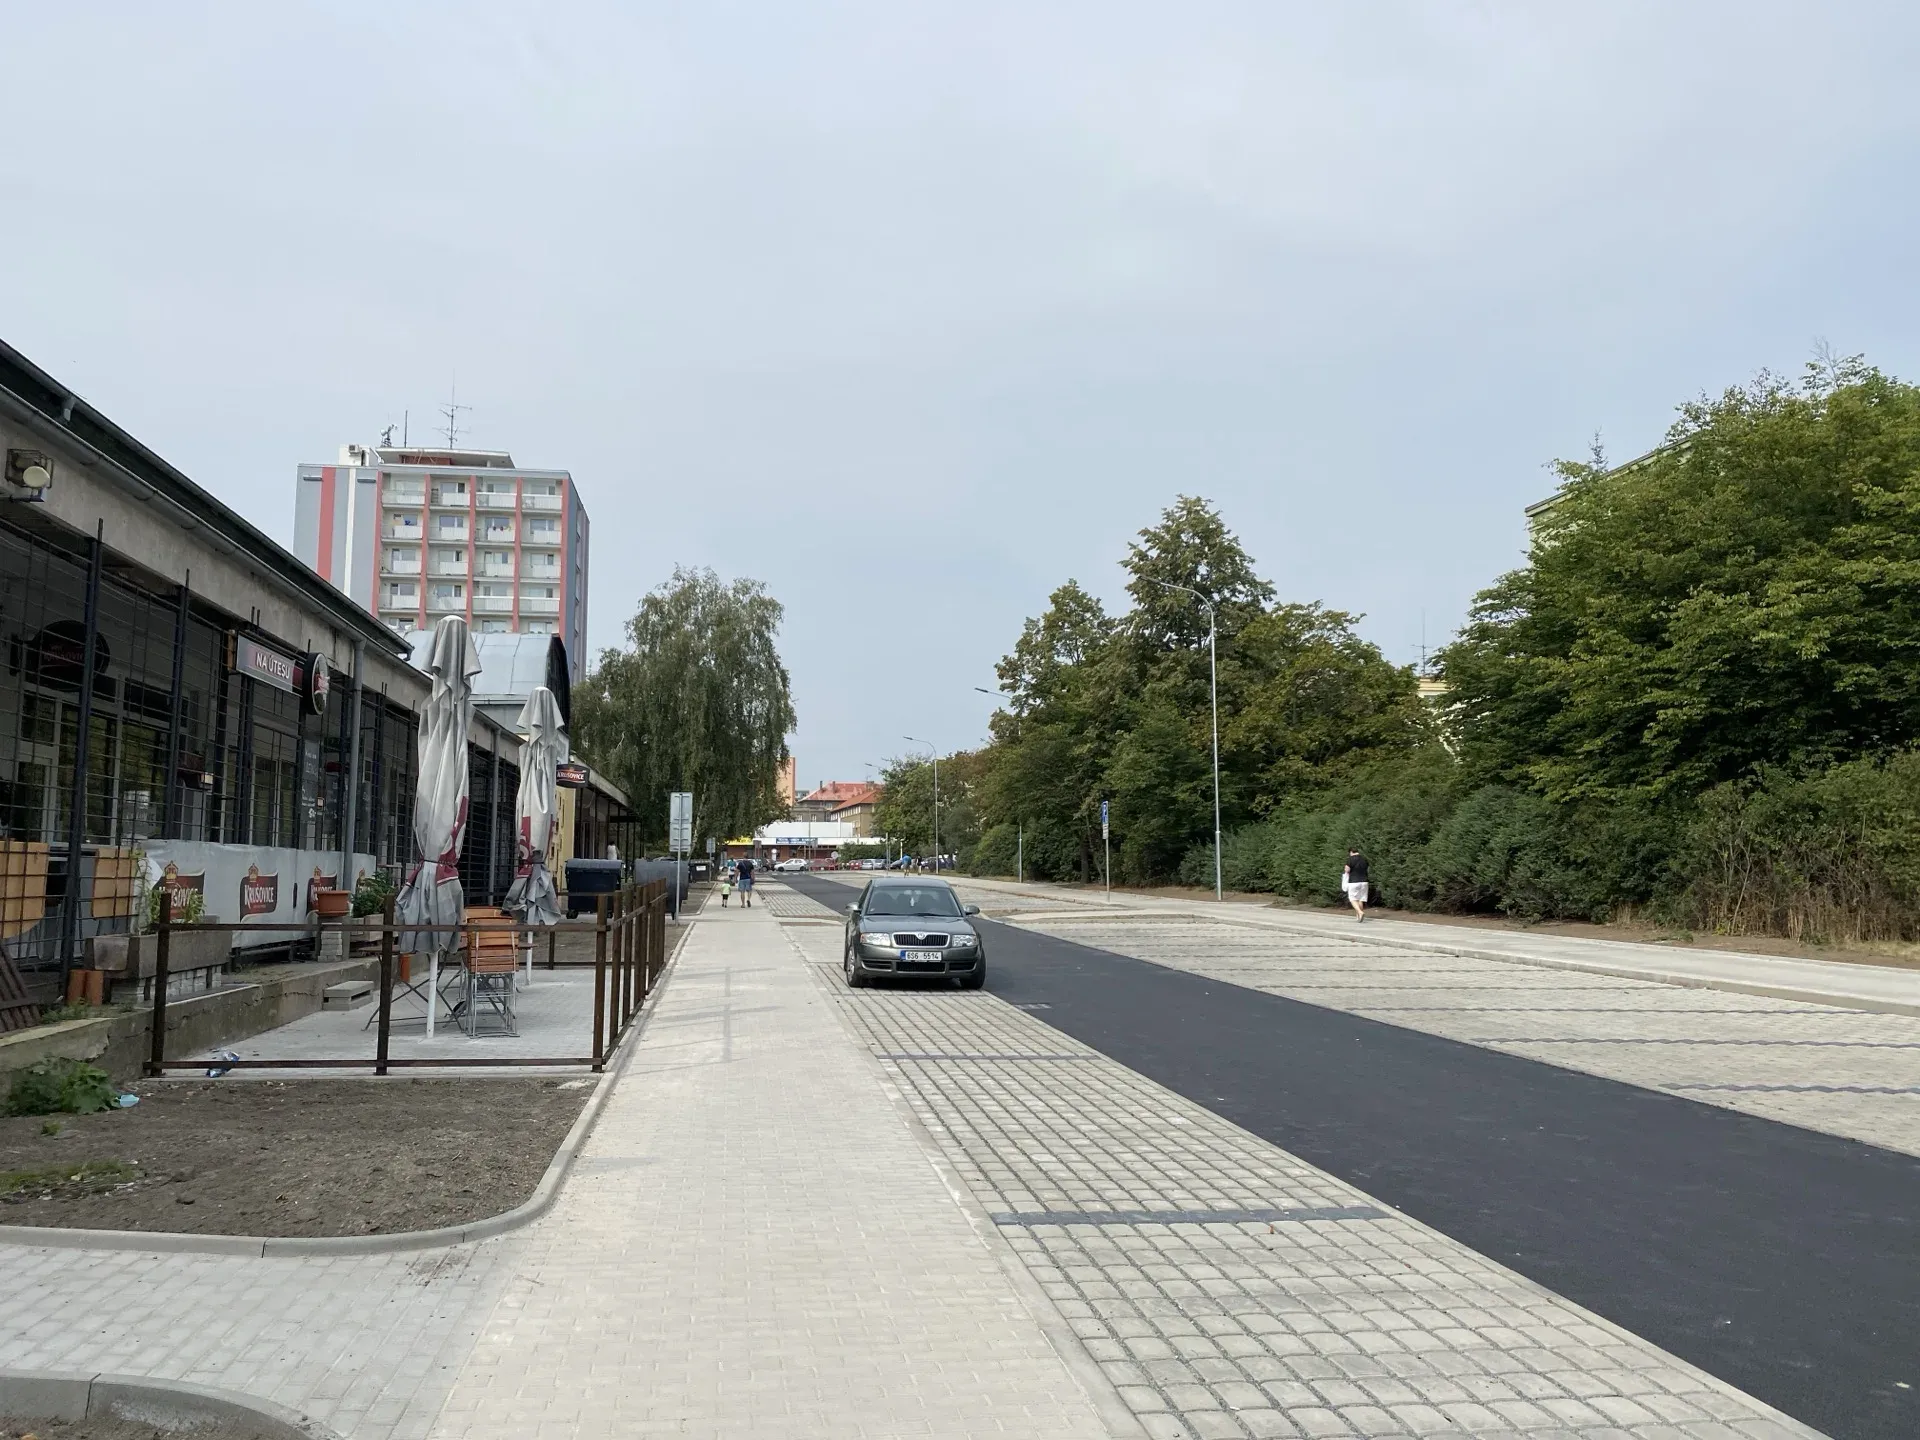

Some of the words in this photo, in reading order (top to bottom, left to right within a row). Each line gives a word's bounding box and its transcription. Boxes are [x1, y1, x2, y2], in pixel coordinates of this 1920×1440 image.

[256, 652, 267, 670] NA
[268, 655, 290, 679] ÚTESU
[244, 884, 274, 908] KRUŠOVICE
[923, 952, 939, 960] 5514
